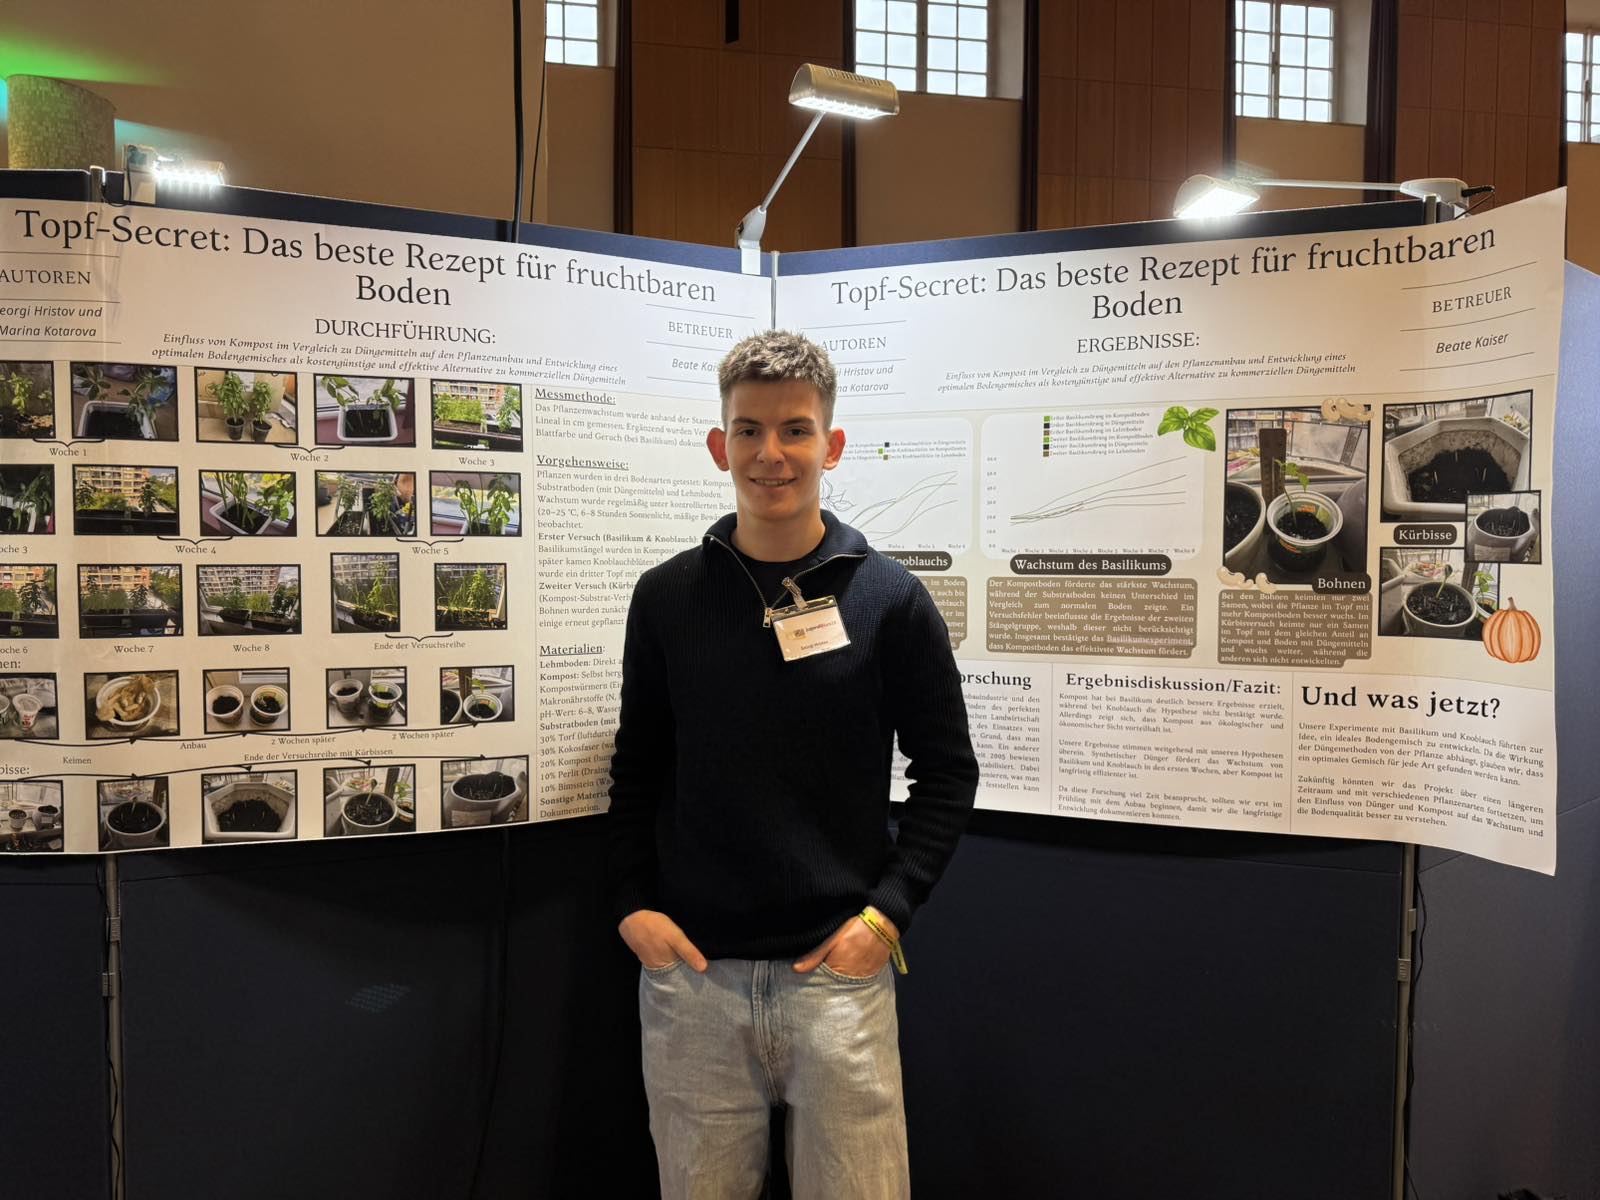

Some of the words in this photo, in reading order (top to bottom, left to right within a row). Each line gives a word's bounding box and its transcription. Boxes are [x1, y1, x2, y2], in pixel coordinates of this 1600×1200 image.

[15, 209, 230, 252] Topf-Secret:
[242, 227, 302, 259] Das
[314, 232, 394, 266] beste
[405, 243, 506, 283] Rezept
[516, 252, 556, 280] für
[566, 258, 715, 302] fruchtbaren
[0, 269, 91, 284] AUTOREN
[831, 274, 986, 311] Topf-Secret:
[996, 268, 1046, 292] Das
[1056, 261, 1129, 287] beste
[1139, 254, 1240, 286] Rezept
[1251, 246, 1296, 274] für
[1307, 229, 1495, 270] fruchtbaren
[355, 275, 451, 306] Boden
[1092, 290, 1183, 319] Boden
[1432, 286, 1512, 313] BETREUER
[34, 306, 75, 317] Hristov
[78, 307, 103, 317] und
[44, 326, 96, 337] Kotarova
[315, 318, 496, 344] DURCHFÜHRUNG:
[668, 321, 733, 339] BETREUER
[822, 336, 886, 351] AUTOREN
[1077, 332, 1199, 353] ERGEBNISSE:
[1435, 340, 1472, 354] Beate
[1475, 333, 1509, 349] Kaiser
[163, 333, 205, 346] Einfluss
[229, 338, 273, 351] Kompost
[276, 341, 289, 350] im
[292, 342, 338, 354] Vergleich
[354, 346, 417, 358] Düngemitteln
[420, 349, 437, 360] auf
[438, 349, 454, 359] den
[457, 351, 524, 364] Pflanzenanbau
[526, 357, 543, 365] und
[544, 357, 596, 373] Entwicklung
[598, 363, 618, 372] eines
[152, 348, 204, 359] optimalen
[207, 350, 287, 364] Bodengemisches
[289, 355, 304, 365] als
[306, 355, 376, 371] kostengünstige
[379, 360, 396, 370] und
[399, 361, 439, 372] effektive
[441, 363, 493, 374] Alternative
[508, 366, 570, 380] kommerziellen
[573, 372, 626, 385] Düngemitteln
[672, 358, 699, 370] Beate
[1165, 360, 1180, 368] den
[1182, 357, 1246, 370] Pflanzenanbau
[1248, 355, 1265, 365] und
[1267, 353, 1322, 364] Entwicklung
[843, 367, 875, 377] Hristov
[876, 364, 894, 375] und
[1166, 370, 1216, 381] Alternative
[1230, 366, 1293, 377] kommerziellen
[1296, 364, 1356, 376] Düngemitteln
[850, 383, 889, 393] Kotarova
[534, 388, 616, 405] Messmethode:
[49, 448, 79, 456] Woche
[290, 453, 321, 462] Woche
[458, 457, 487, 465] Woche
[536, 454, 629, 471] Vorgehensweise:
[538, 532, 565, 541] Erster
[568, 533, 601, 541] Versuch
[603, 533, 644, 542] (Basilikum
[654, 535, 699, 544] Knoblauch):
[1399, 529, 1452, 540] Kürbisse
[175, 545, 208, 554] Woche
[1015, 559, 1074, 570] Wachstum
[1078, 559, 1097, 570] des
[1101, 559, 1167, 570] Basilikums
[1318, 577, 1366, 589] Bohnen
[114, 644, 145, 653] Woche
[232, 644, 262, 652] Woche
[374, 642, 394, 650] Ende
[395, 642, 409, 650] der
[411, 640, 466, 649] Versuchsreihe
[539, 643, 605, 657] Materialien:
[1066, 673, 1280, 694] Ergebnisdiskussion/Fazit:
[1301, 686, 1357, 706] Und
[1367, 694, 1419, 710] was
[1426, 691, 1500, 719] jetzt?
[278, 737, 310, 745] Wochen
[312, 736, 336, 746] später
[431, 731, 455, 740] später
[1299, 722, 1326, 730] Unsere
[1329, 723, 1379, 733] Experimente
[1399, 726, 1439, 737] Basilikum
[1442, 731, 1457, 739] und
[1459, 732, 1497, 747] Knoblauch
[1498, 739, 1527, 752] führten
[1529, 746, 1544, 754] zur
[180, 742, 206, 750] Anbau
[1298, 733, 1317, 741] Idee,
[1335, 734, 1362, 742] ideales
[1365, 736, 1423, 746] Bodengemisch
[1439, 743, 1481, 755] entwickeln.
[1483, 748, 1493, 757] Da
[1495, 751, 1506, 760] die
[1509, 753, 1544, 768] Wirkung
[63, 756, 92, 764] Keimen
[244, 753, 264, 762] Ende
[282, 751, 337, 759] Versuchsreihe
[339, 749, 353, 757] mit
[355, 748, 393, 756] Kürbissen
